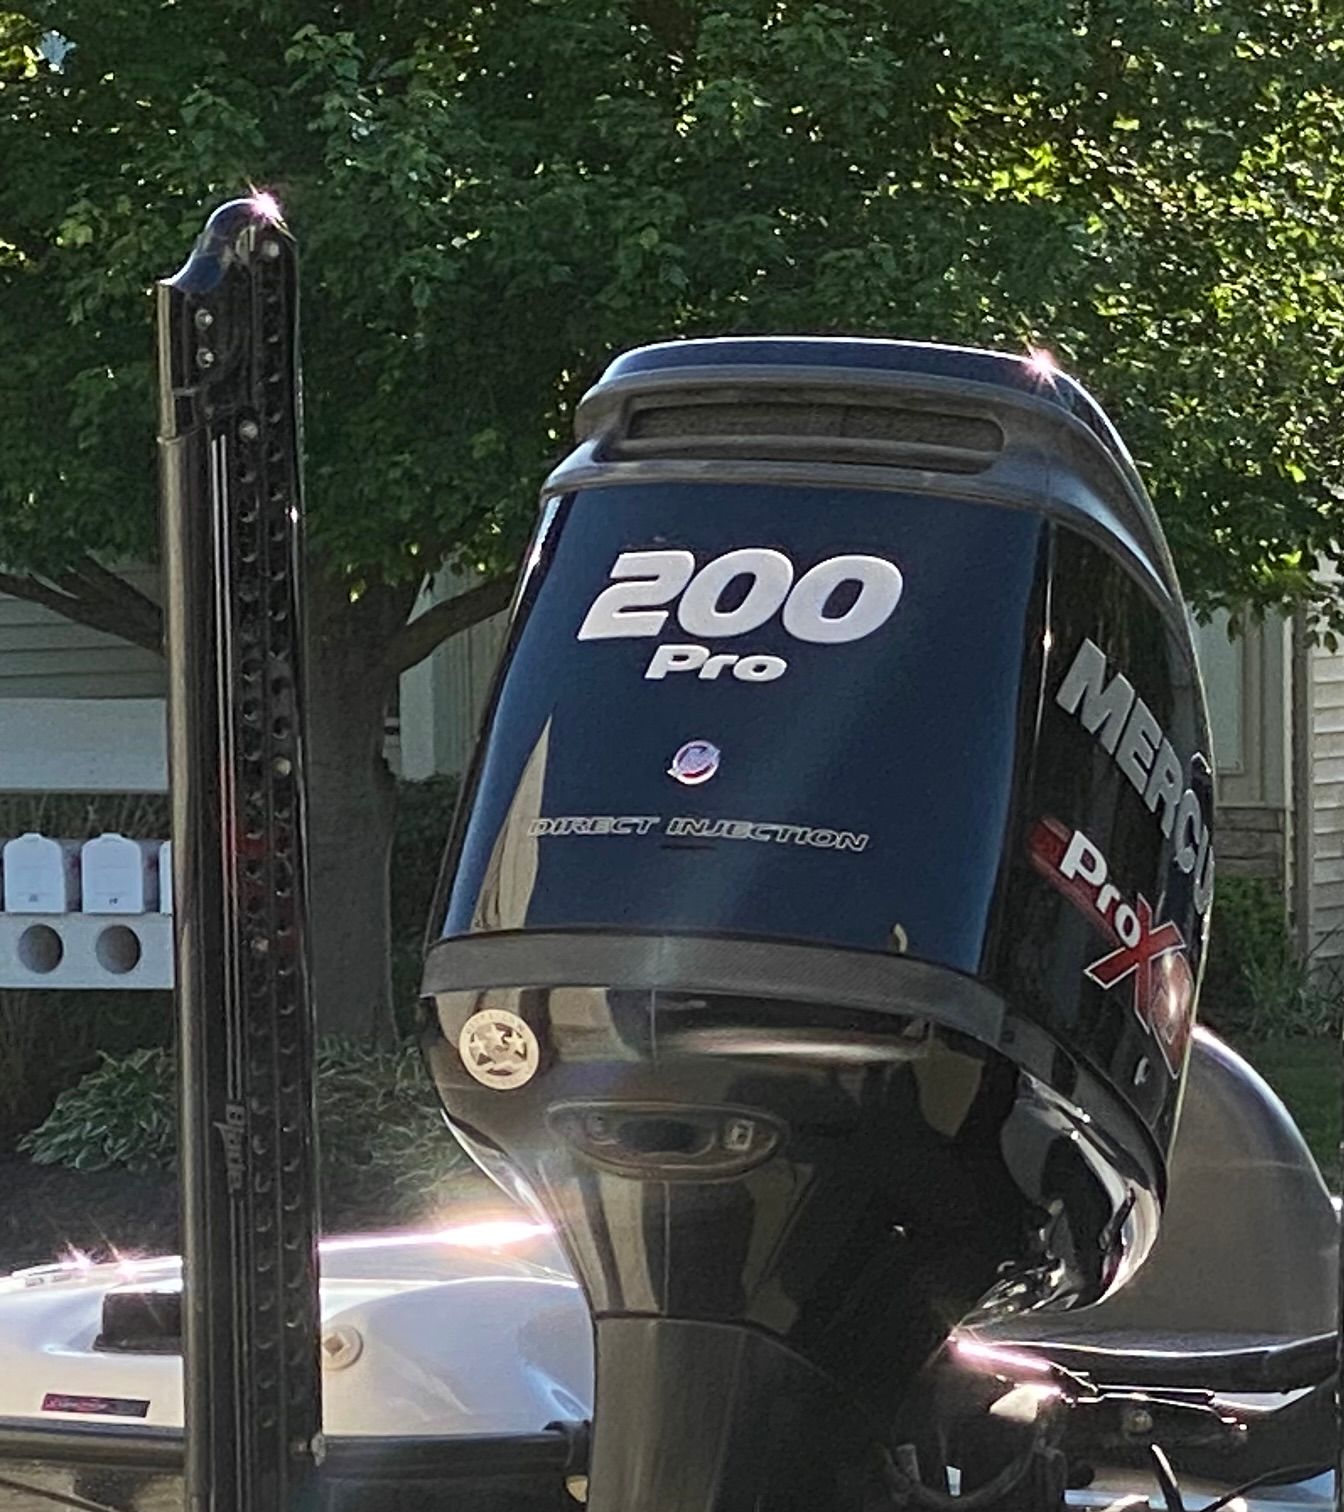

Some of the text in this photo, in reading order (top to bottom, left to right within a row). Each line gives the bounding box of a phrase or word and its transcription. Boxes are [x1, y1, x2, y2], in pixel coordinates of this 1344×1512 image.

[577, 547, 904, 643] 200
[643, 644, 788, 682] Pro
[1055, 637, 1215, 915] MERCU
[527, 815, 870, 853] DIRECT INJECTION
